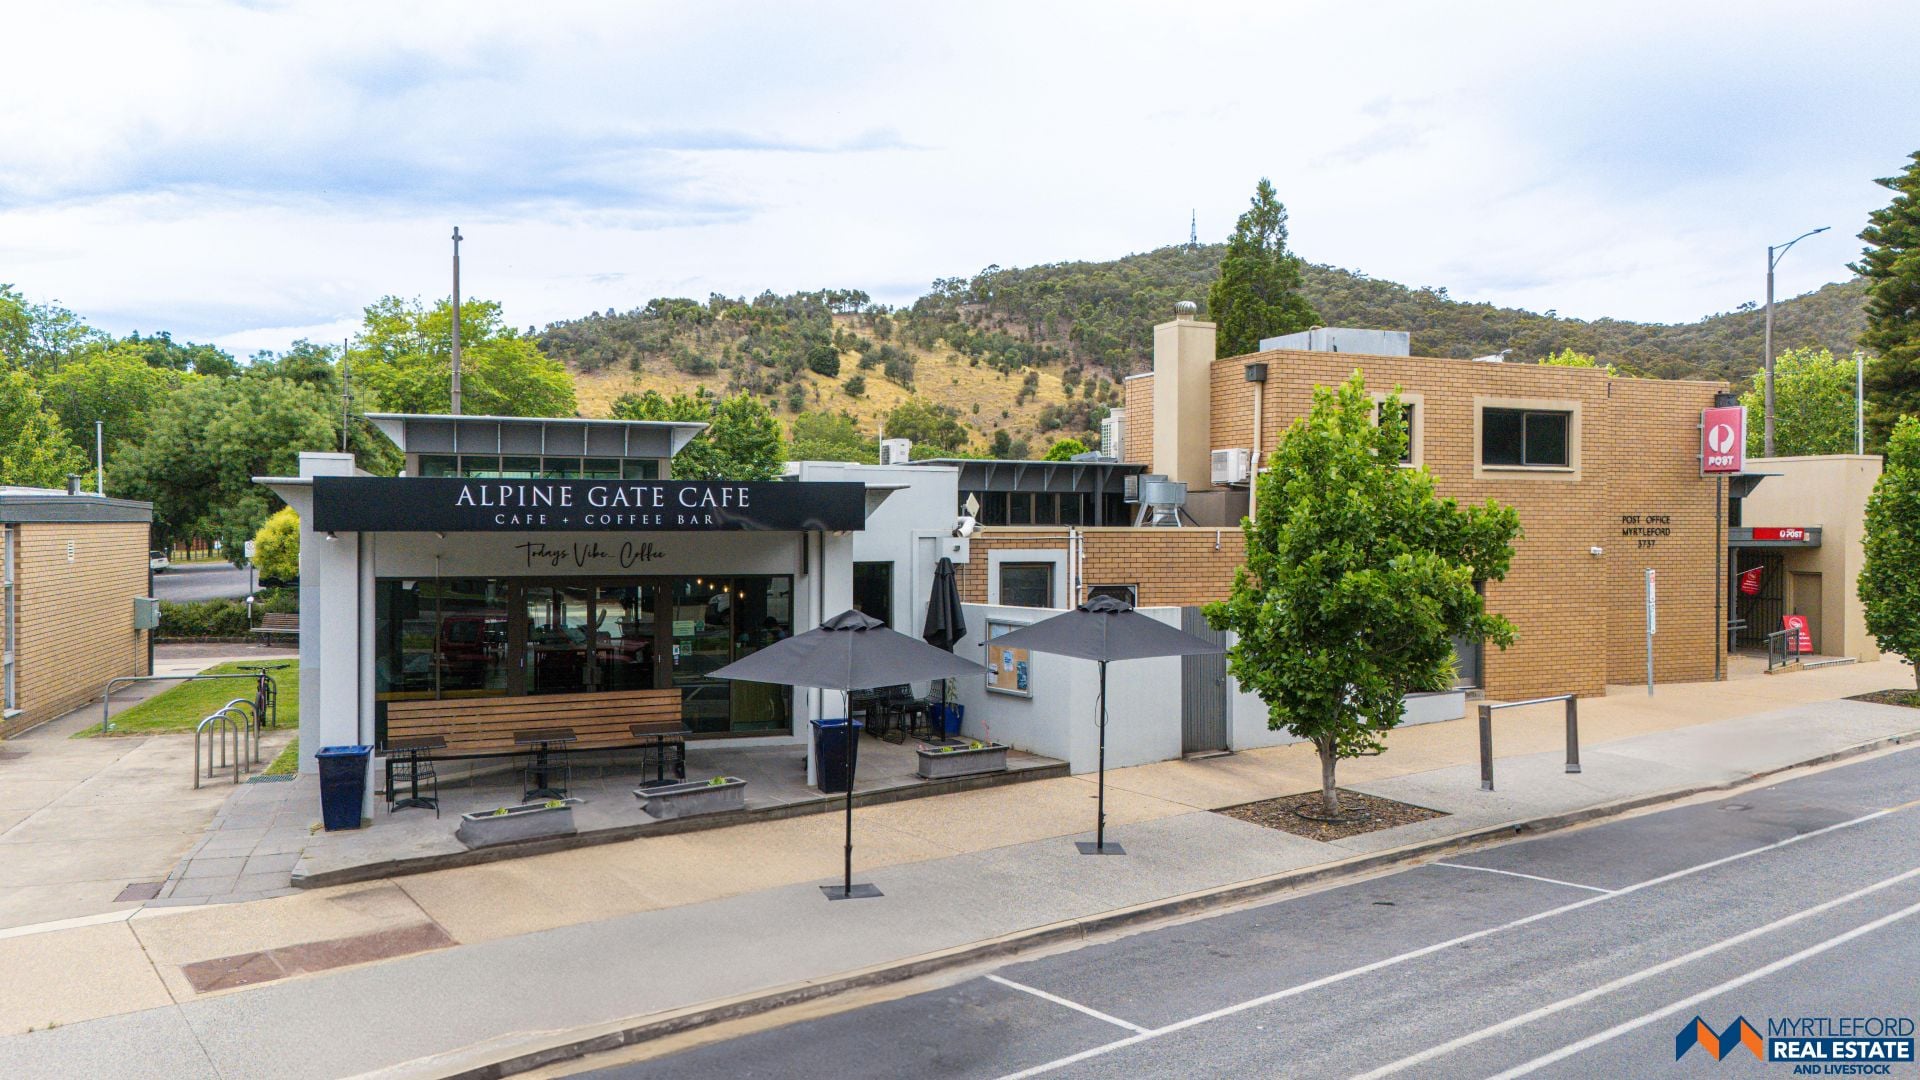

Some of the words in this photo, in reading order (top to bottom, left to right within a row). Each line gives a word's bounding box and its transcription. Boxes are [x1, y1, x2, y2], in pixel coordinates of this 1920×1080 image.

[1708, 456, 1734, 466] POST
[455, 485, 573, 507] ALPINE
[587, 486, 664, 507] GATE
[678, 487, 751, 508] CAFE
[495, 514, 547, 525] CAFE
[585, 514, 662, 525] COFFEE
[677, 514, 715, 525] BAR
[1622, 515, 1640, 524] POST
[1646, 515, 1671, 524] OFFICE
[1622, 527, 1671, 536] MYRTLEFORD
[1786, 530, 1803, 538] POST
[1637, 539, 1656, 549] 3737
[515, 541, 568, 567] Todays
[620, 541, 665, 568] Coffee
